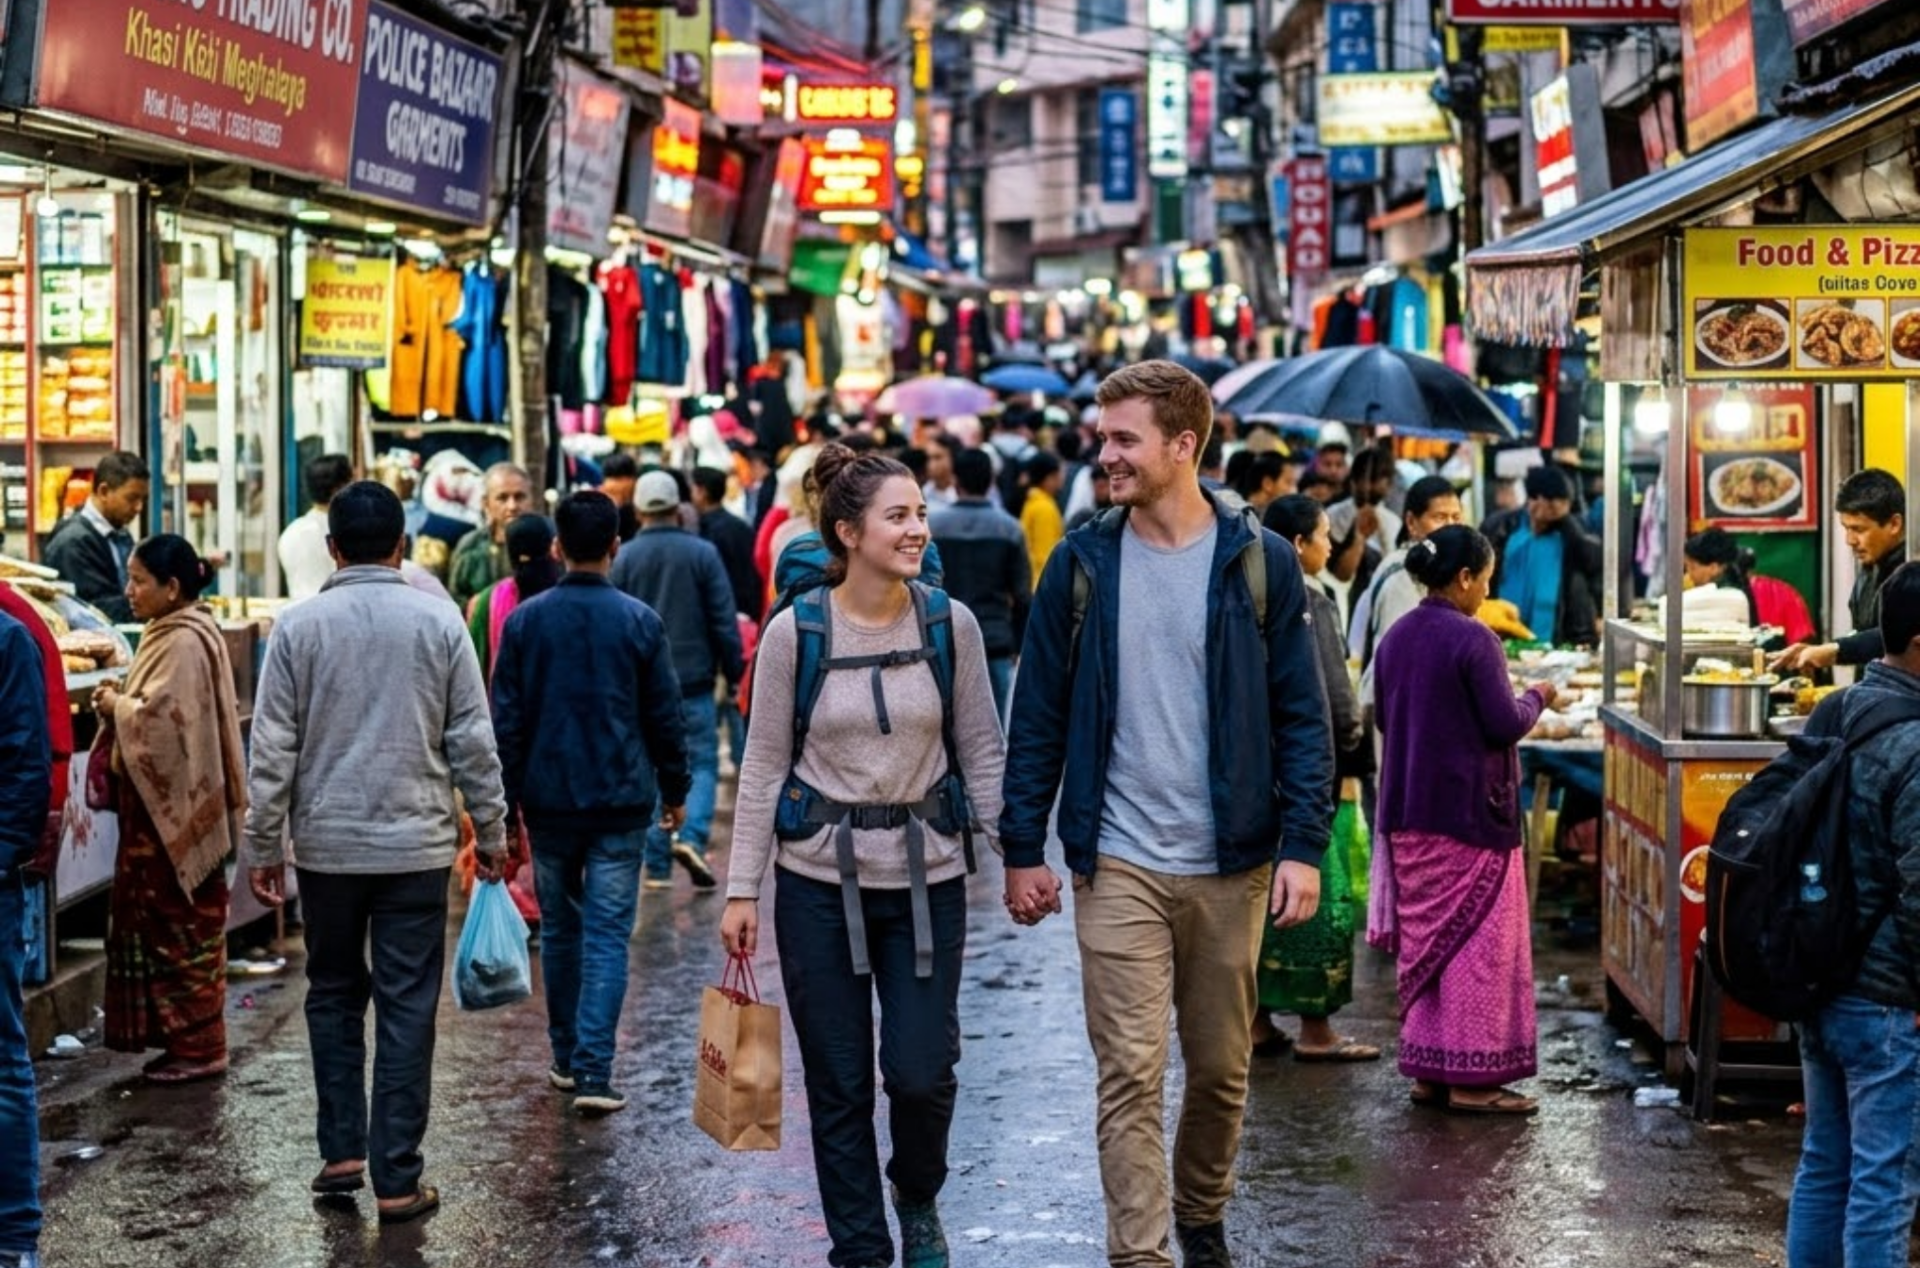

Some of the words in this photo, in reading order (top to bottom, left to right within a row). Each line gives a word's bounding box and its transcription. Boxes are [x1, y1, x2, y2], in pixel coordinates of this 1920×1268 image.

[125, 7, 182, 68] Khasi
[322, 0, 354, 63] CO.
[364, 14, 429, 95] POLICE
[429, 41, 497, 123] BAZAAR
[1738, 237, 1814, 266] Food
[1827, 237, 1849, 266] &
